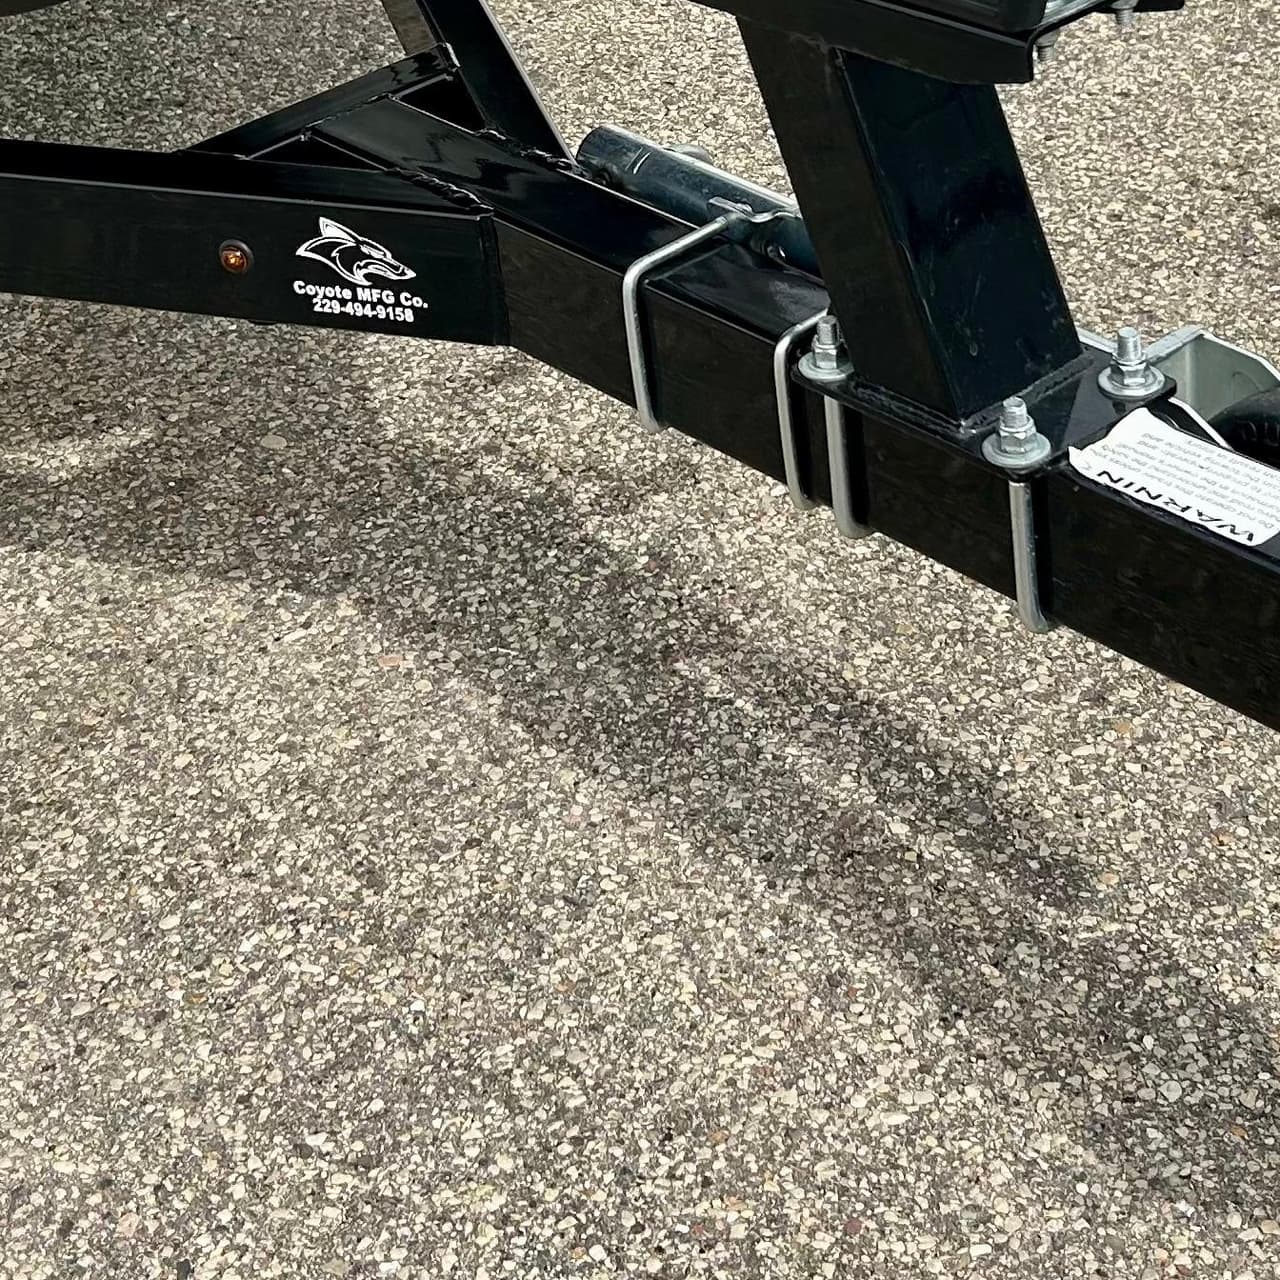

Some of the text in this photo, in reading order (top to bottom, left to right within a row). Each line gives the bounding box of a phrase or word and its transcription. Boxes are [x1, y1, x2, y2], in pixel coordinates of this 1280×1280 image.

[293, 280, 428, 308] Coyote MFG Co.
[312, 298, 414, 322] 229-494-9158
[1097, 470, 1253, 541] WARNIN
